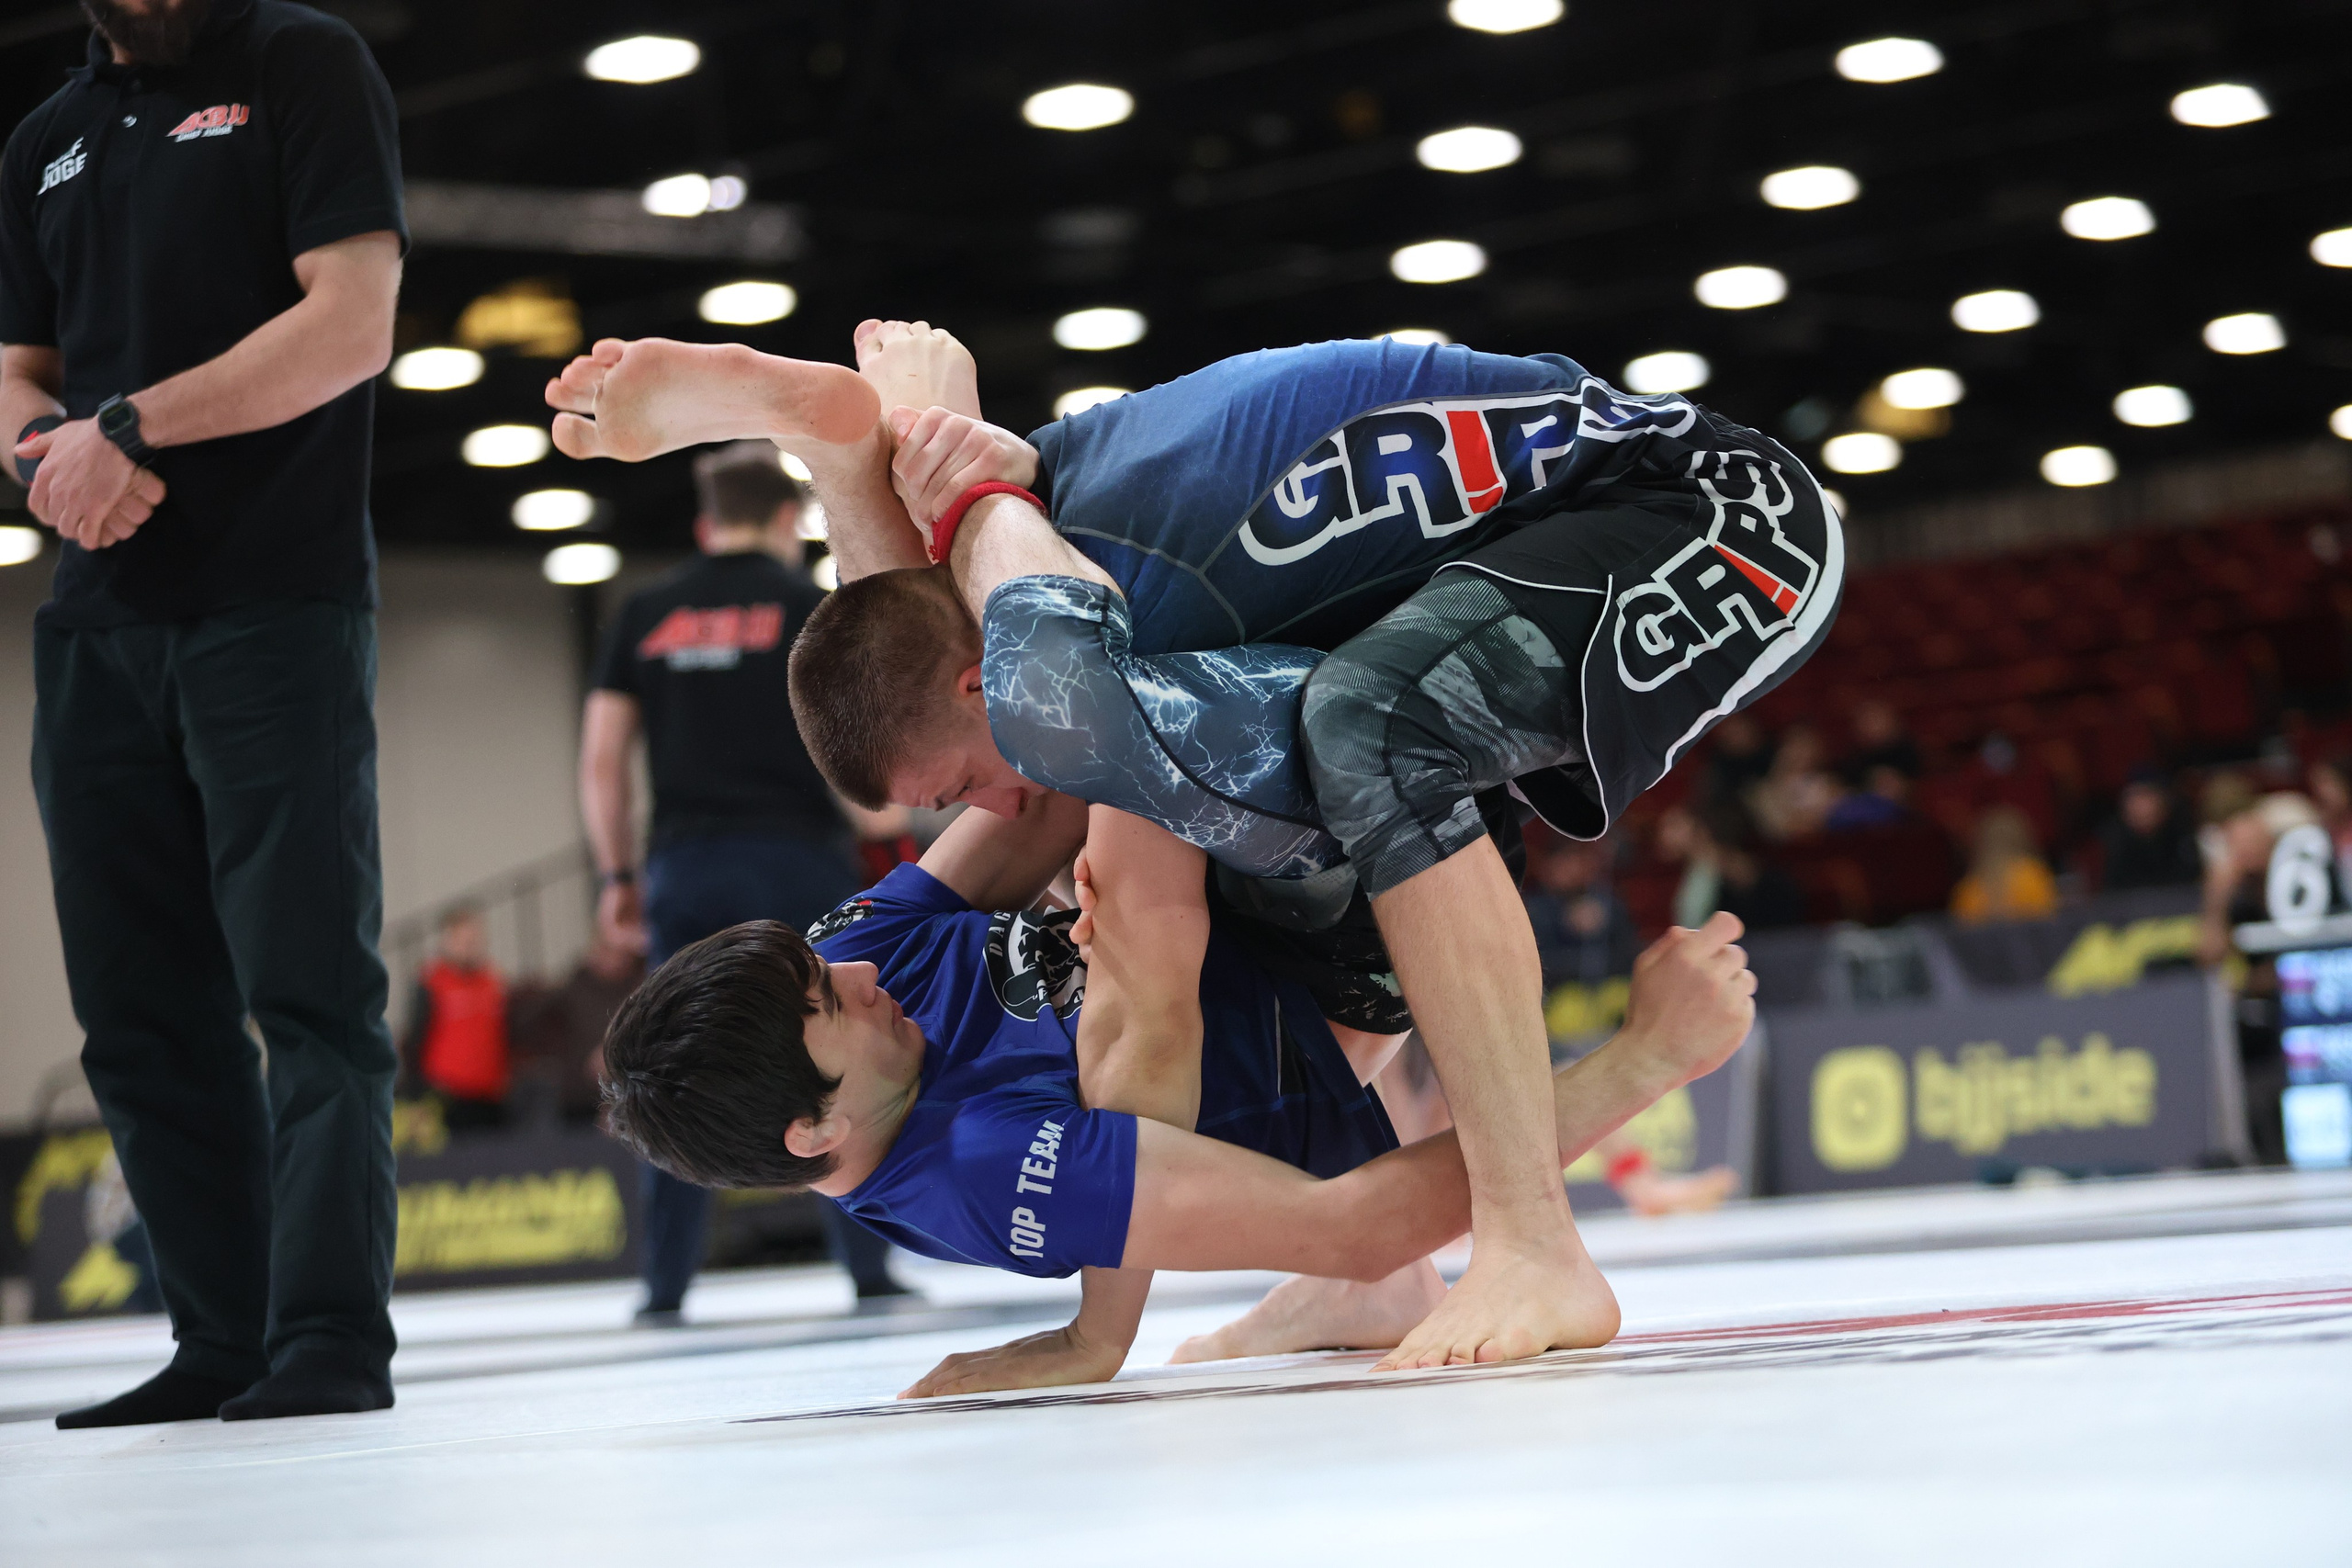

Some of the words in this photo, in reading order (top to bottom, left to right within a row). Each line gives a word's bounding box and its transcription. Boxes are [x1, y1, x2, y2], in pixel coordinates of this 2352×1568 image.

[1614, 449, 1820, 693] GRIPS
[2266, 824, 2333, 938] 6
[1016, 1119, 1065, 1195] TEAM
